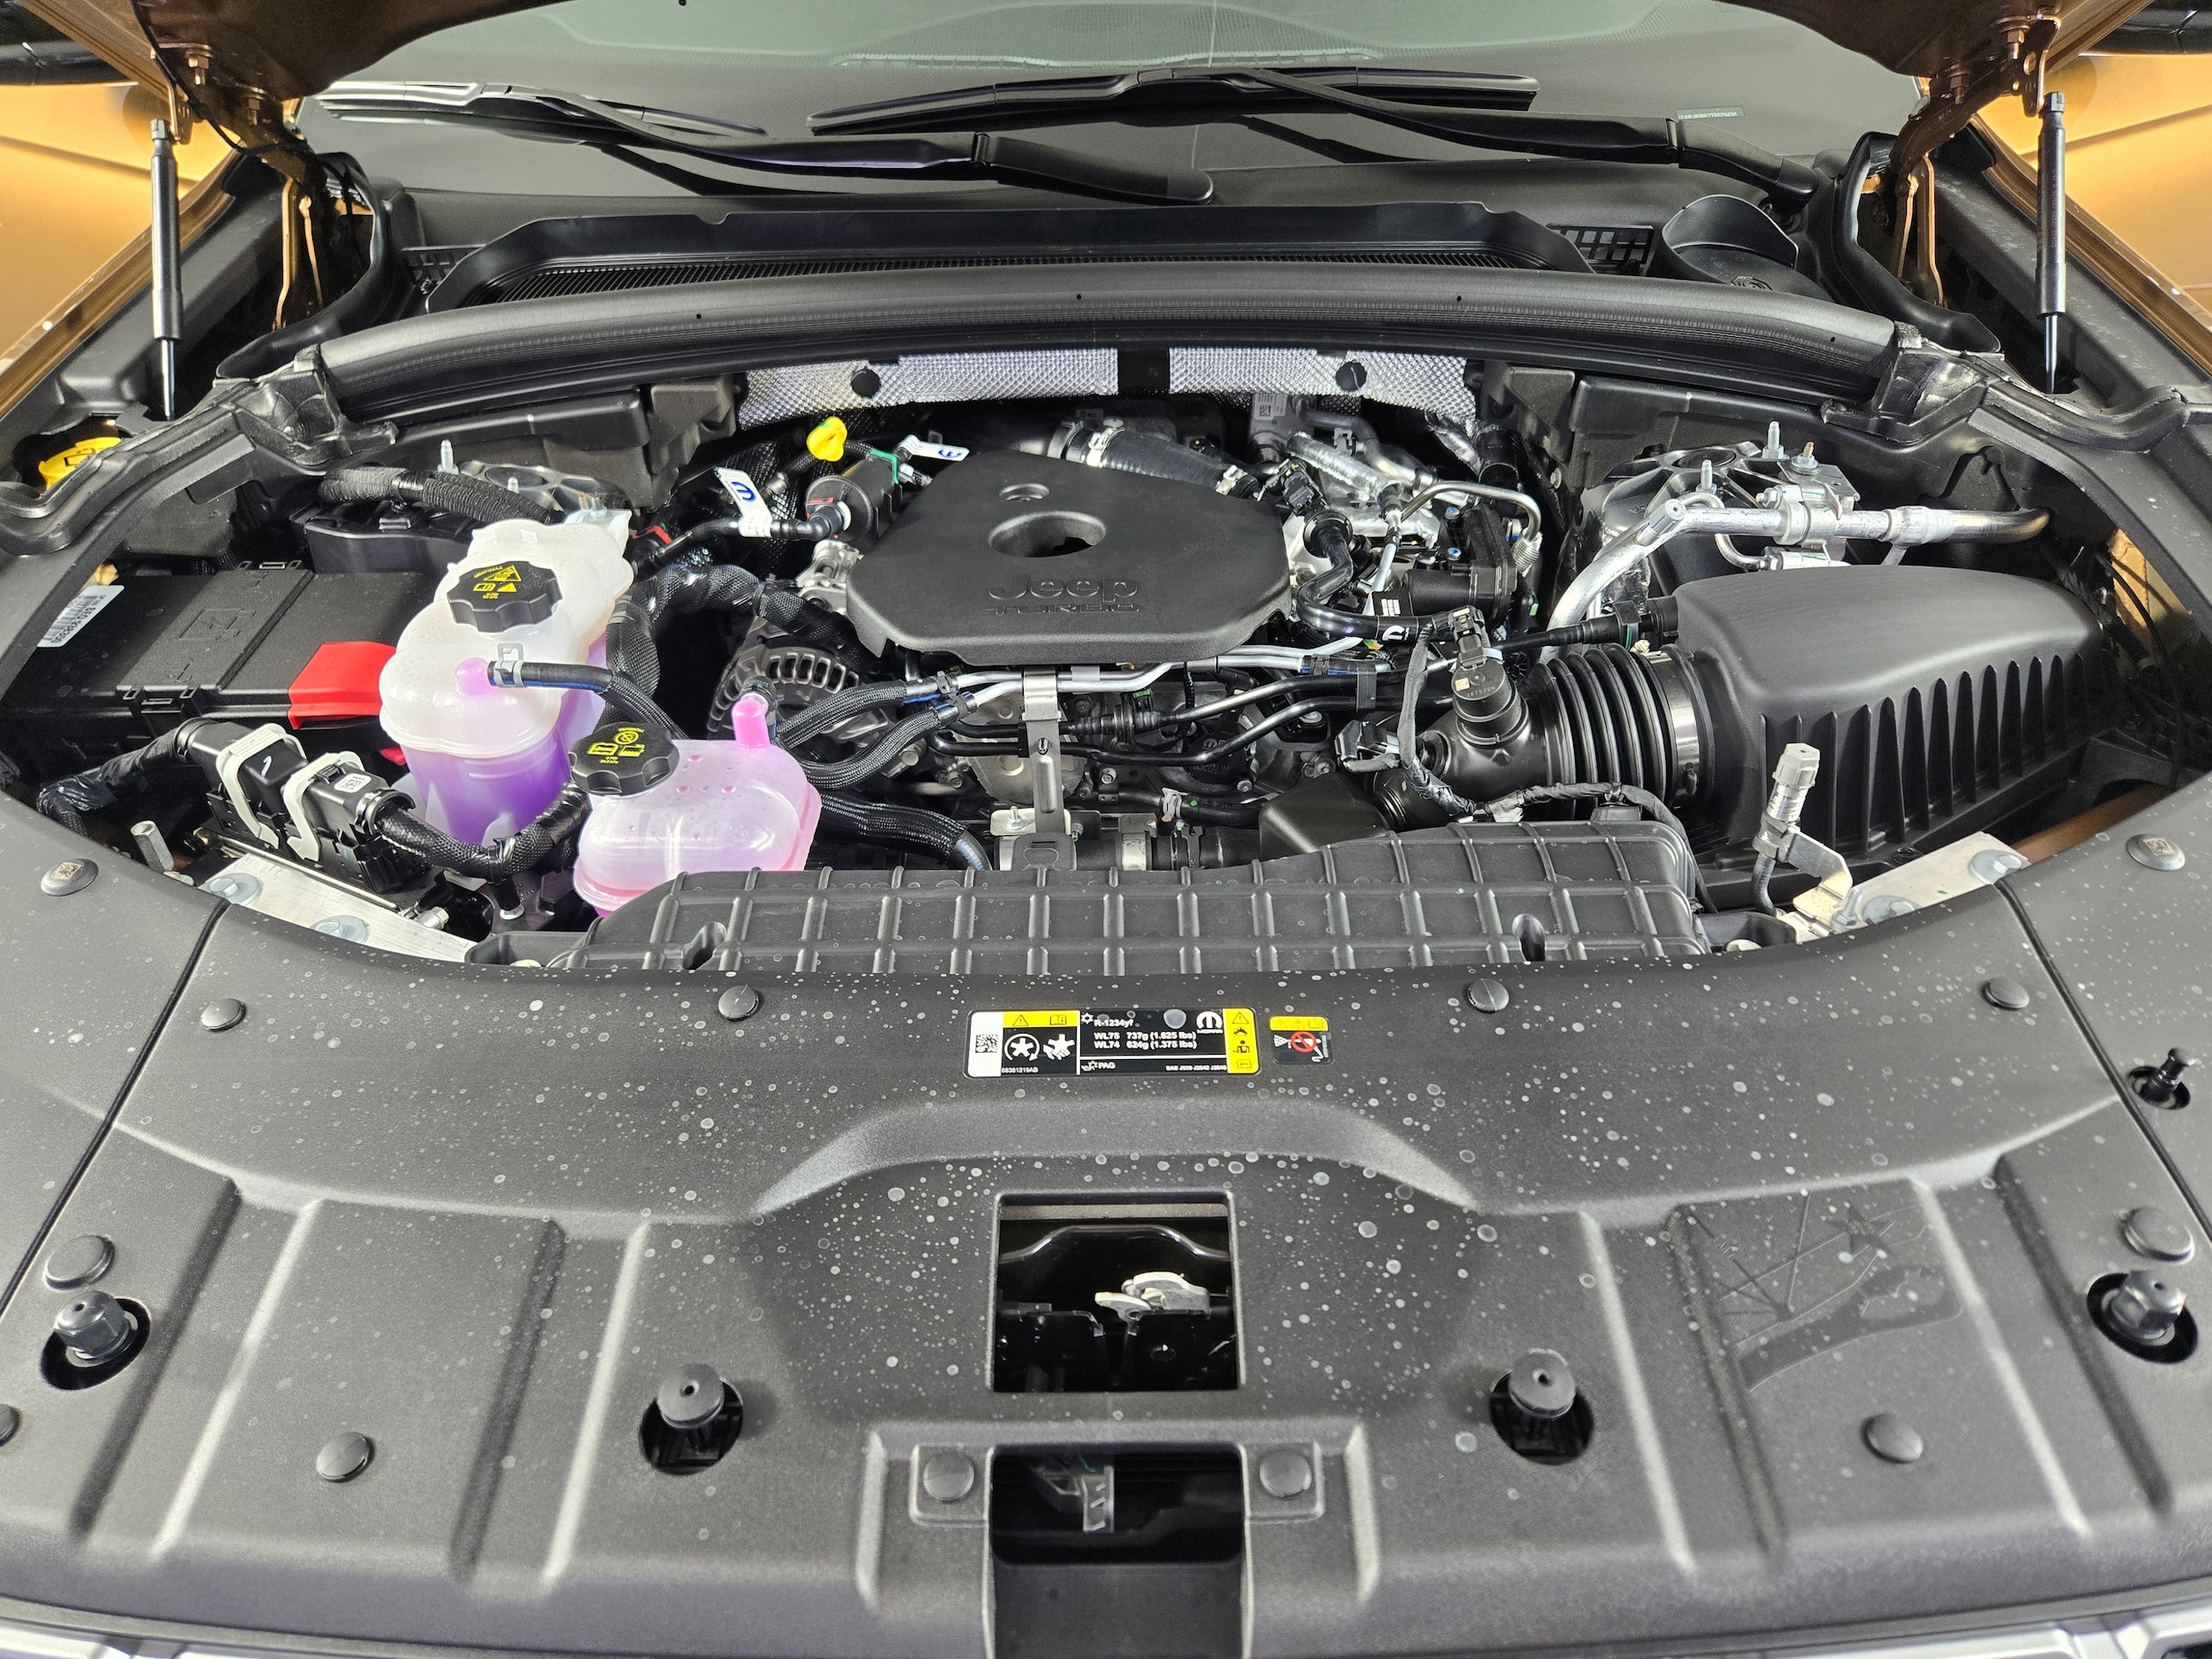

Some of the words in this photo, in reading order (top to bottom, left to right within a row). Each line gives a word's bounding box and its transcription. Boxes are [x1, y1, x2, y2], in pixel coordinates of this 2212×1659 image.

[988, 574, 1138, 603] Jeep
[986, 604, 1141, 615] TURBO
[1094, 1018, 1134, 1028] R-1234yf
[1094, 1032, 1121, 1041] WL75
[1125, 1032, 1149, 1041] 737g
[1149, 1031, 1178, 1041] (1.625
[1178, 1031, 1197, 1041] lbs)
[1094, 1040, 1121, 1049] WL74
[1125, 1040, 1149, 1051] 624g
[1149, 1040, 1179, 1050] (1.375
[1179, 1040, 1198, 1050] lbs)
[1097, 1061, 1117, 1070] PAG
